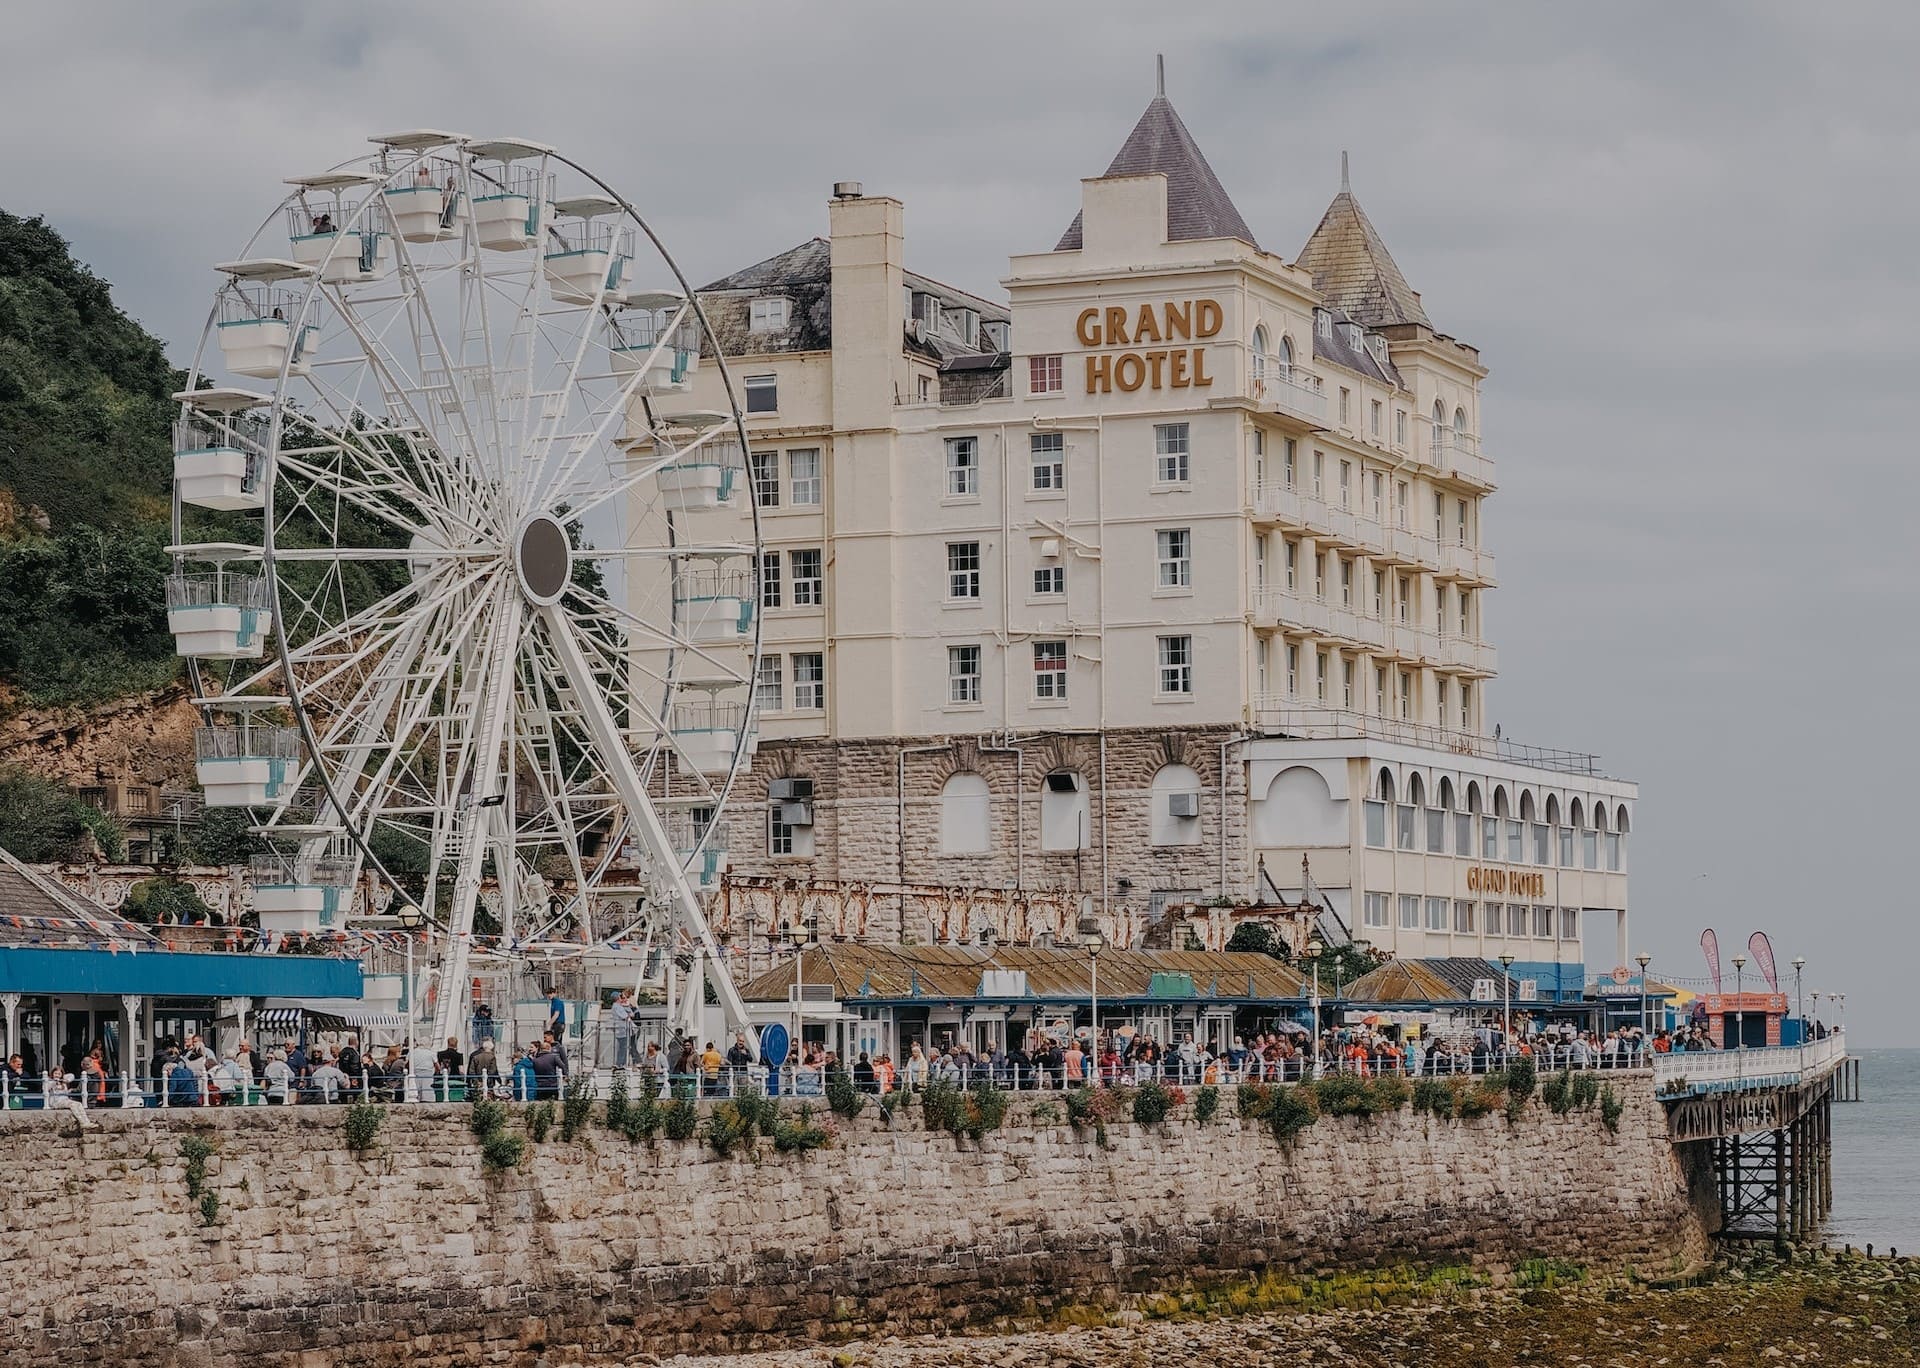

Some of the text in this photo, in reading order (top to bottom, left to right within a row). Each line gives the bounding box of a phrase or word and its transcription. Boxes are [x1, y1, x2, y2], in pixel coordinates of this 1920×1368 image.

[1076, 299, 1223, 346] GRAND
[1086, 348, 1213, 394] HOTEL
[1509, 871, 1544, 897] HOTEL
[1601, 984, 1641, 994] DONUTS
